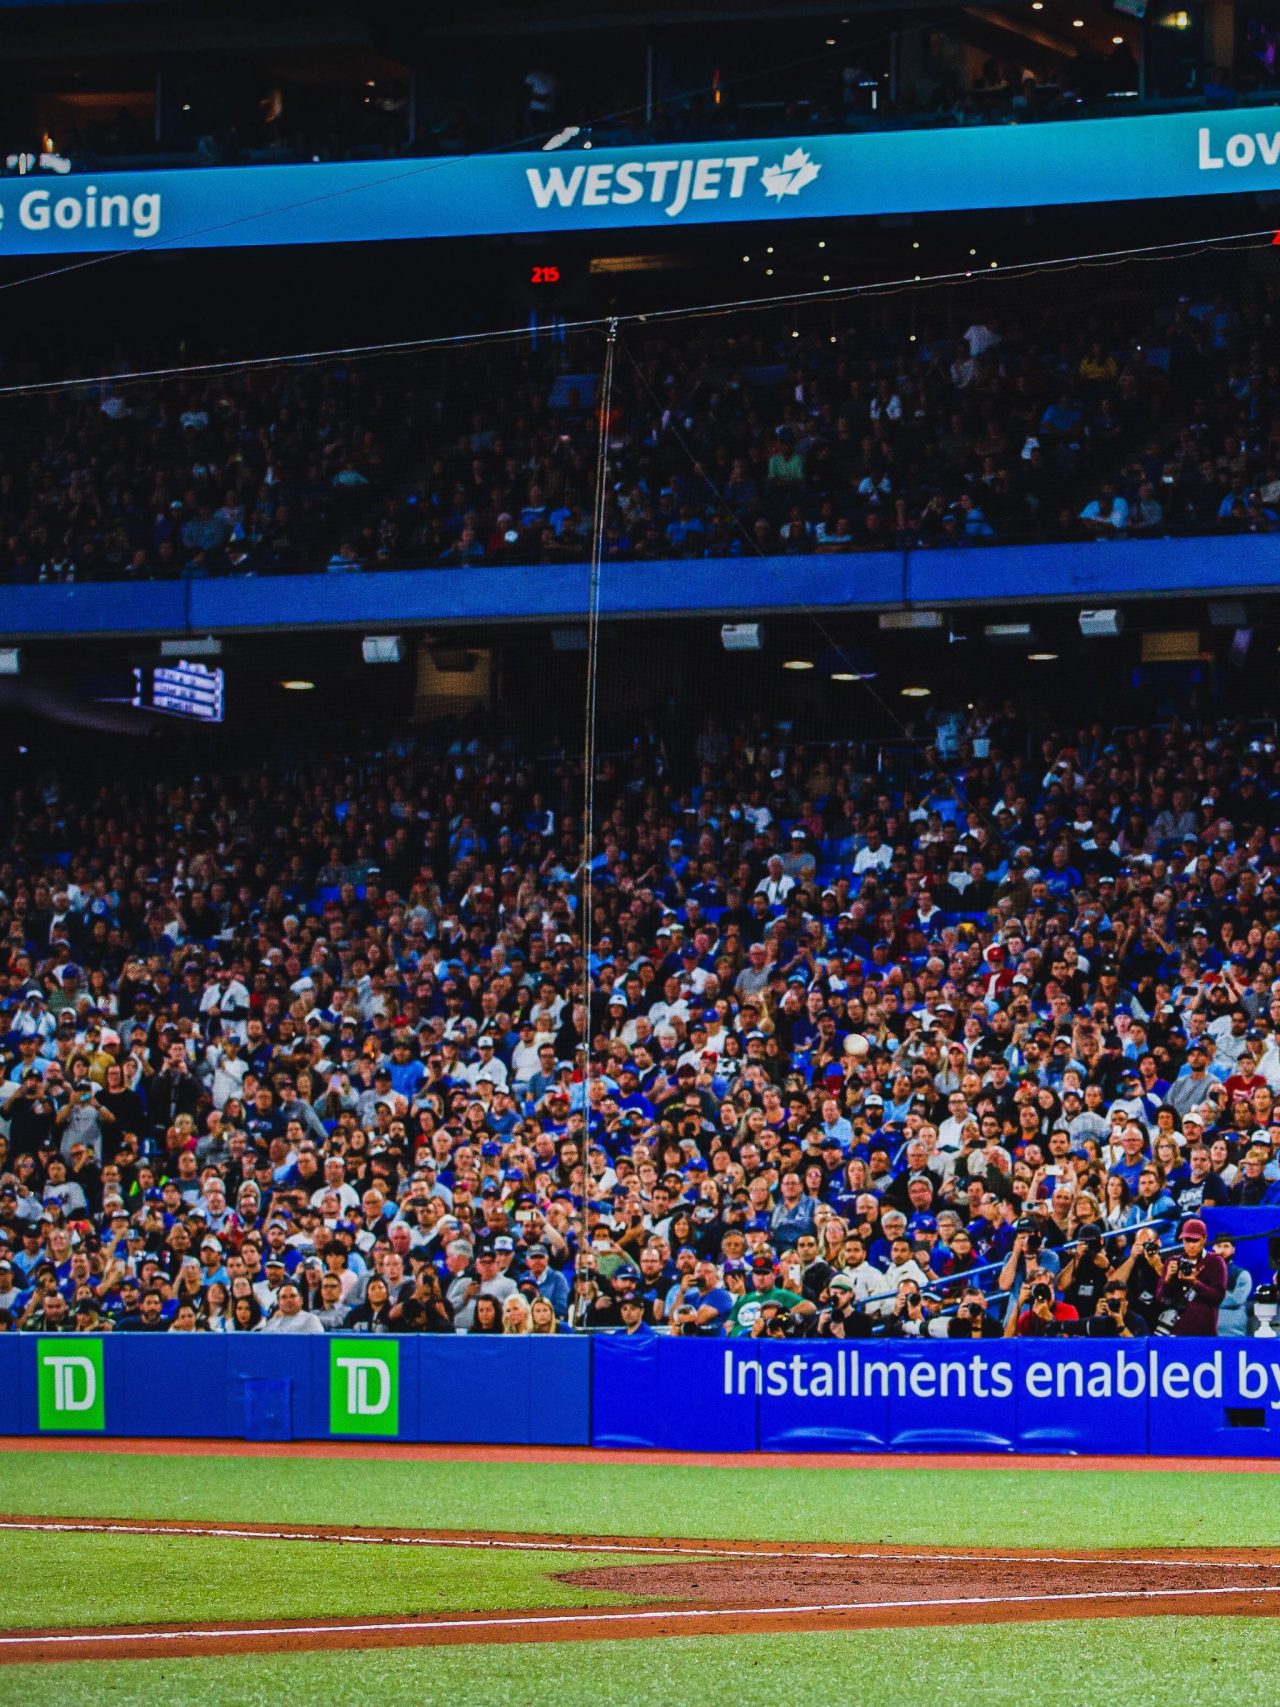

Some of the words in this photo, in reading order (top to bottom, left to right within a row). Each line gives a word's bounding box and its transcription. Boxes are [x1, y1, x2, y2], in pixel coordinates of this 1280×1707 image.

[19, 185, 161, 238] Going
[526, 156, 759, 217] WESTJET
[531, 267, 560, 283] 215
[43, 1356, 96, 1410] TD
[336, 1357, 391, 1415] TD
[724, 1350, 1013, 1398] Installments
[1025, 1350, 1222, 1399] enabled
